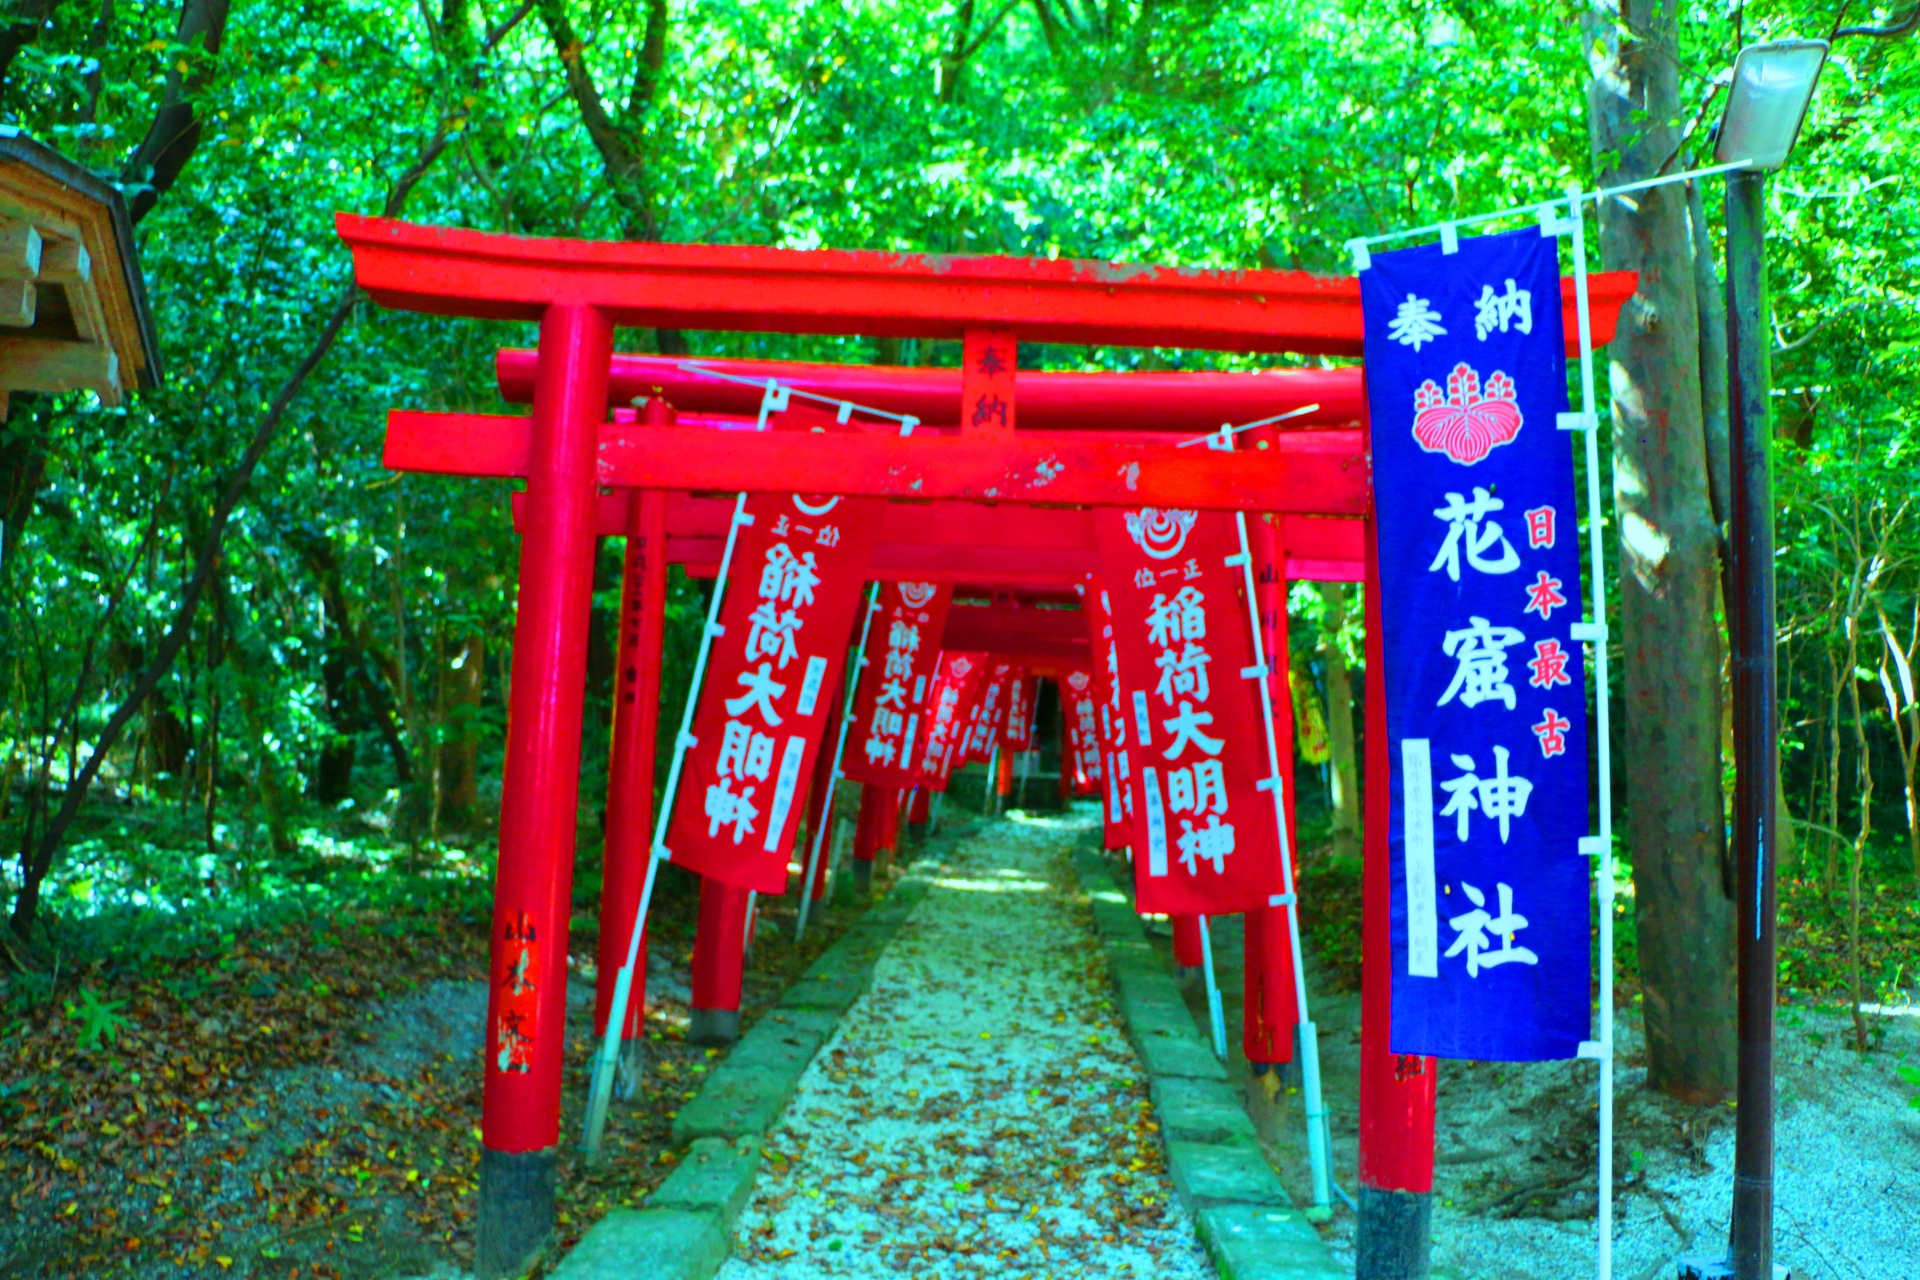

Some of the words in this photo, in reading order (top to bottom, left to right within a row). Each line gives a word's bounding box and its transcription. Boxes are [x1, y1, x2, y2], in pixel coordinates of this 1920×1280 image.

[972, 345, 1007, 428] 奉納
[1388, 278, 1533, 353] 奉納
[1145, 585, 1236, 877] 稲荷大明神
[1429, 486, 1539, 979] 花窟神社
[1523, 505, 1572, 759] 日本最古
